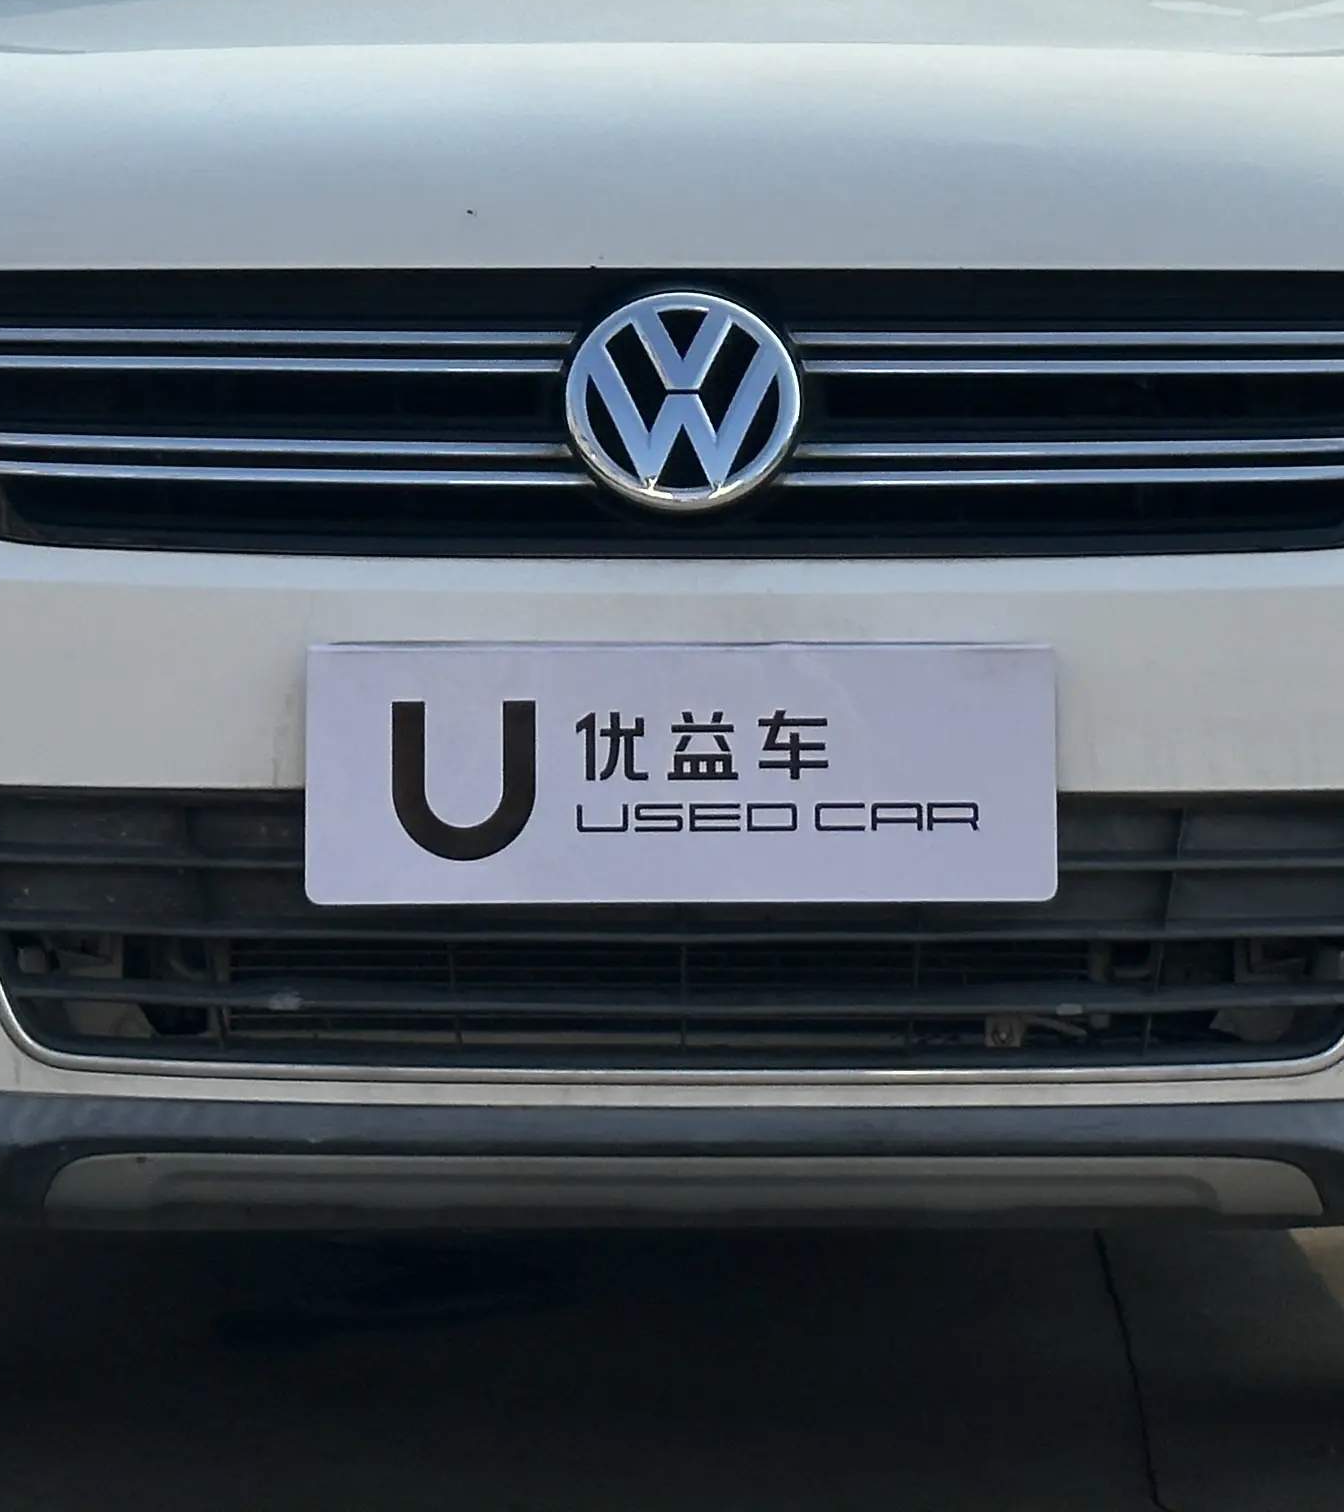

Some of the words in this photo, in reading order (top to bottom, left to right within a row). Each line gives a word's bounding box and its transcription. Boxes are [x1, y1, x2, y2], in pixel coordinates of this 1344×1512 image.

[391, 700, 537, 862] U
[575, 709, 829, 782] 优益车
[576, 802, 798, 833] USED
[814, 802, 980, 832] CAR
